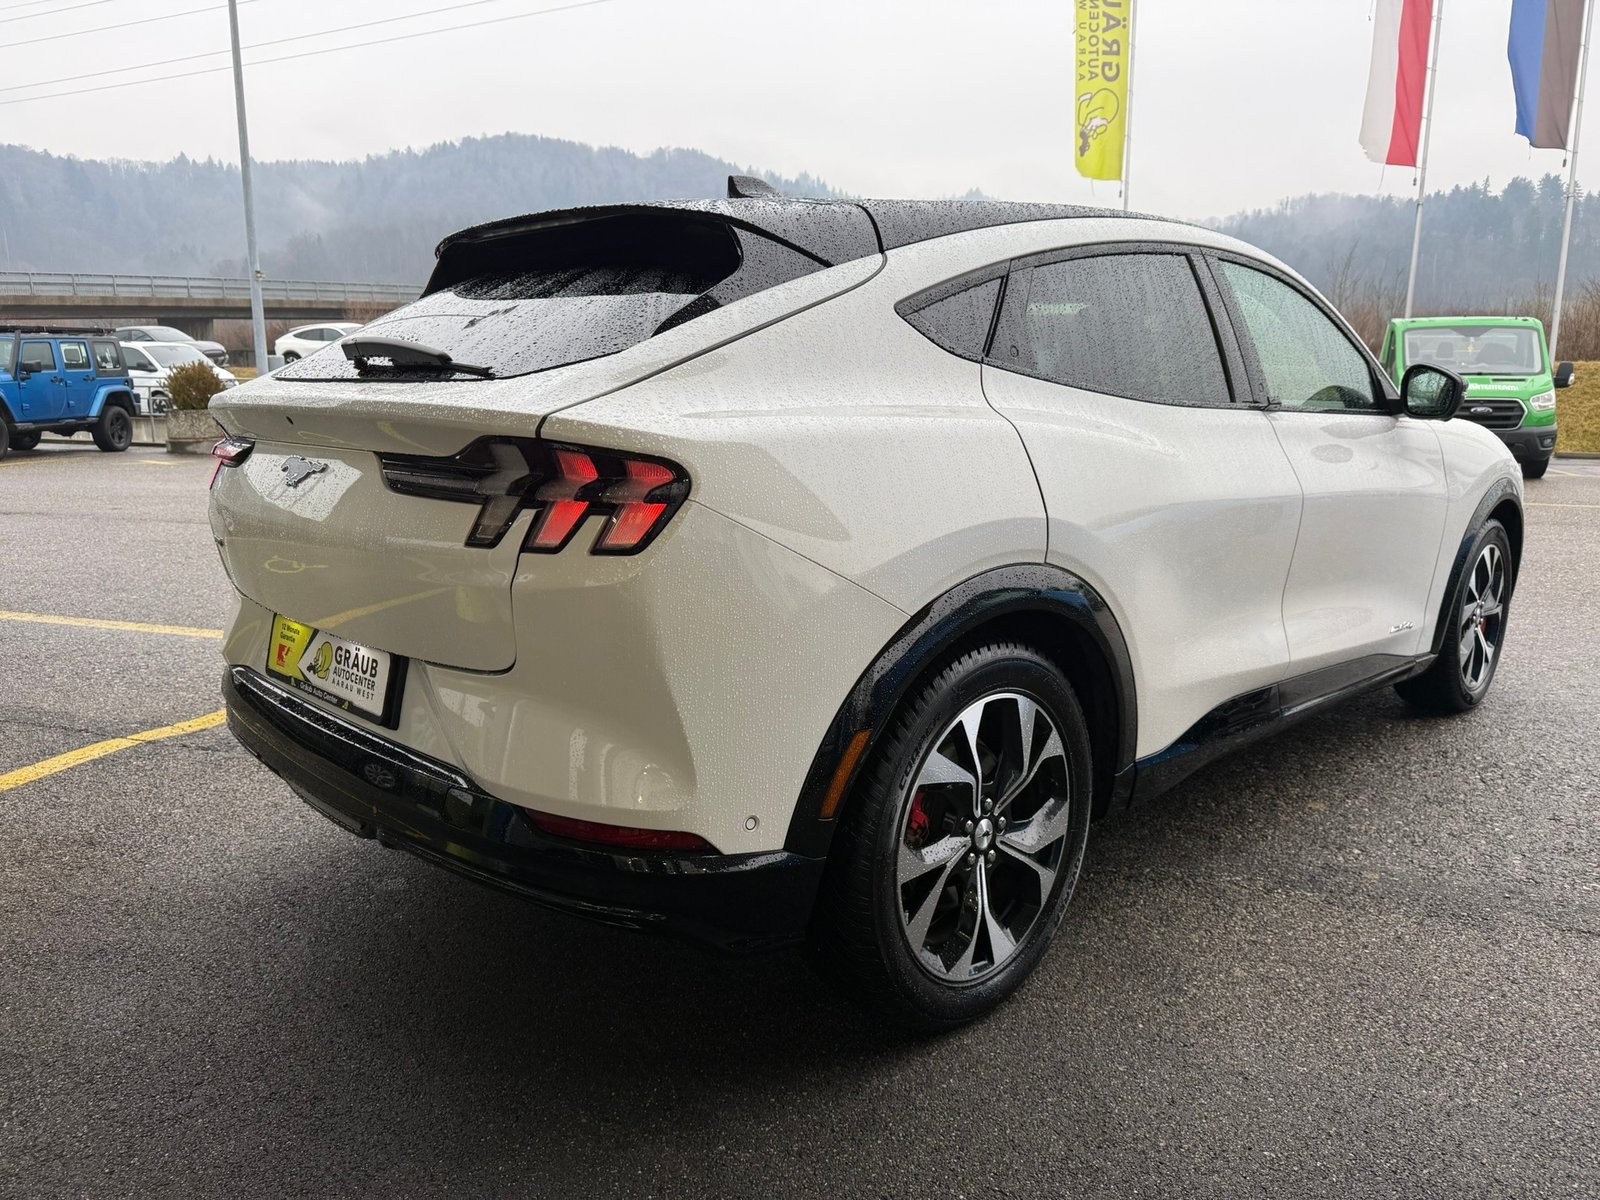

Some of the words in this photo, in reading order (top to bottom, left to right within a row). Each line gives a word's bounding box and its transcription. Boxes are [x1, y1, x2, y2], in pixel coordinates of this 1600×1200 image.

[335, 646, 379, 678] GRÄUB
[332, 677, 354, 692] AARAU
[356, 688, 374, 701] WEST
[333, 666, 376, 691] AUTOCENTER
